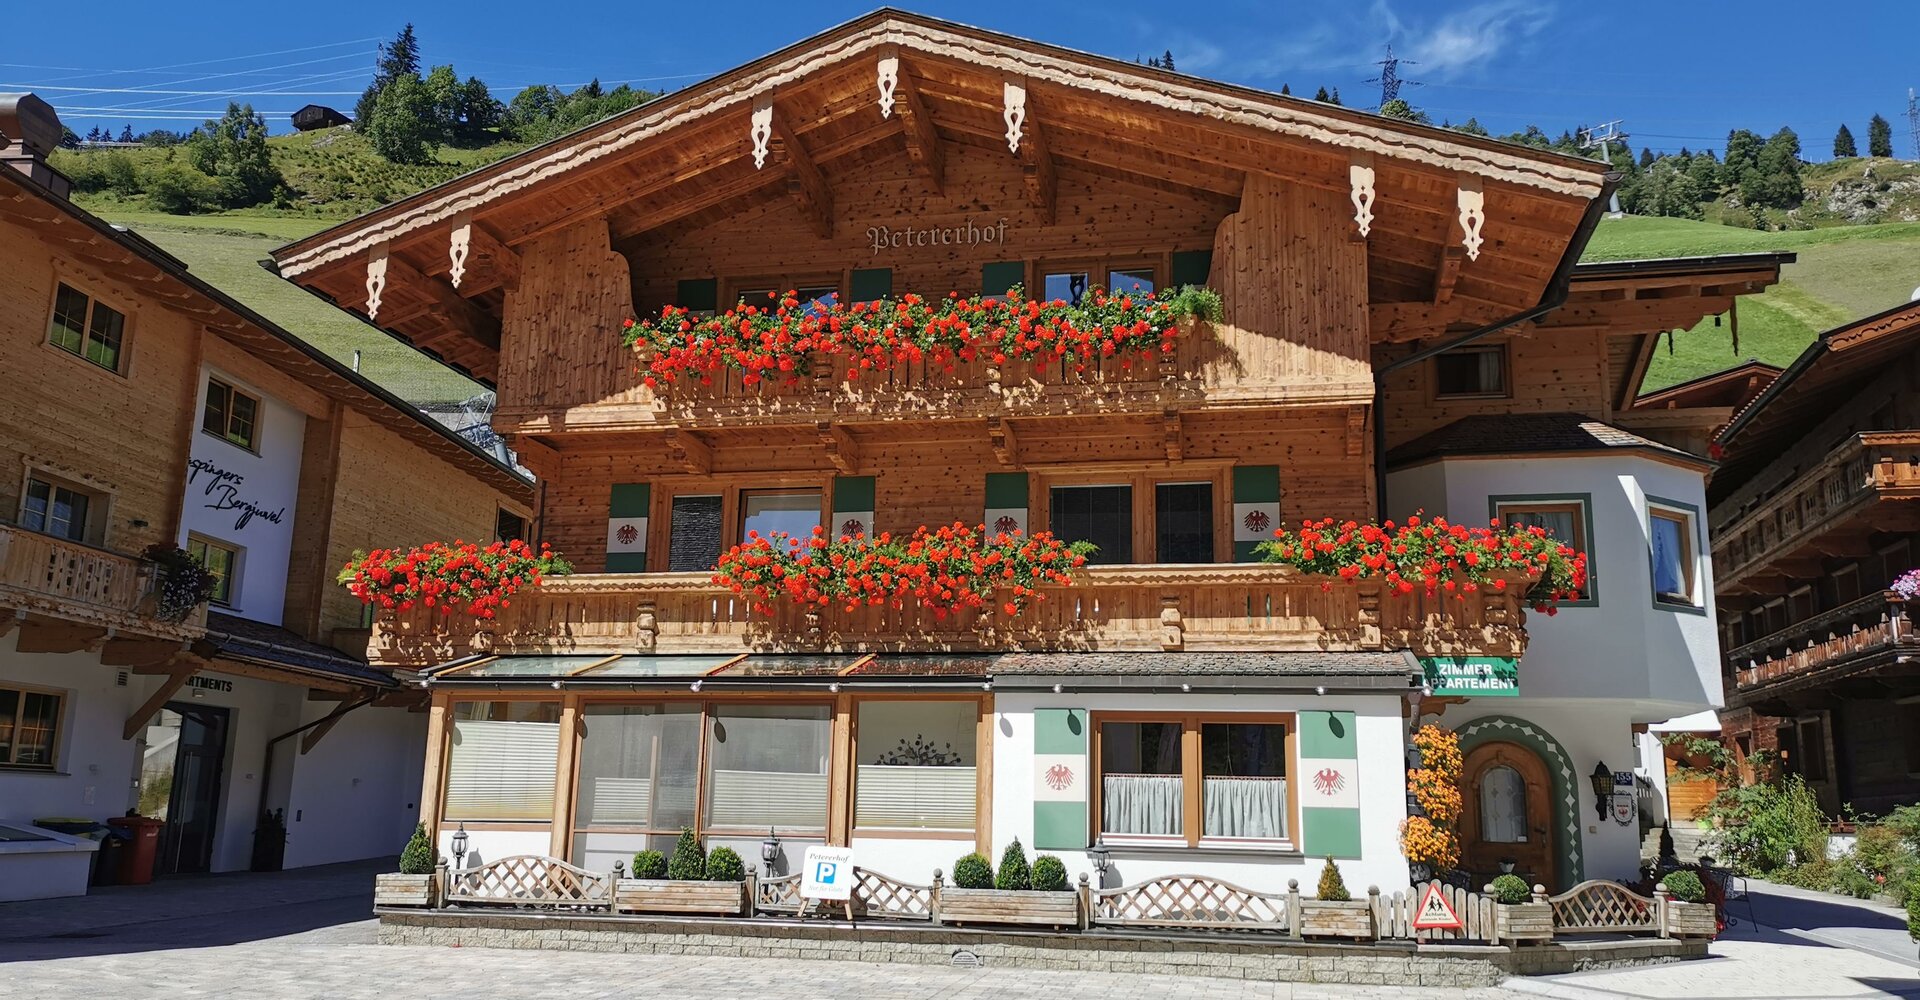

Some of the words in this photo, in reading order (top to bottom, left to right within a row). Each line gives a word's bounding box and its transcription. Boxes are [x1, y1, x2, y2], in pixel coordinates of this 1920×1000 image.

[866, 217, 1009, 256] Petererhof
[1438, 663, 1493, 676] ZIMMER
[1615, 772, 1632, 782] 155
[809, 853, 851, 864] Petererhof
[817, 862, 835, 883] P
